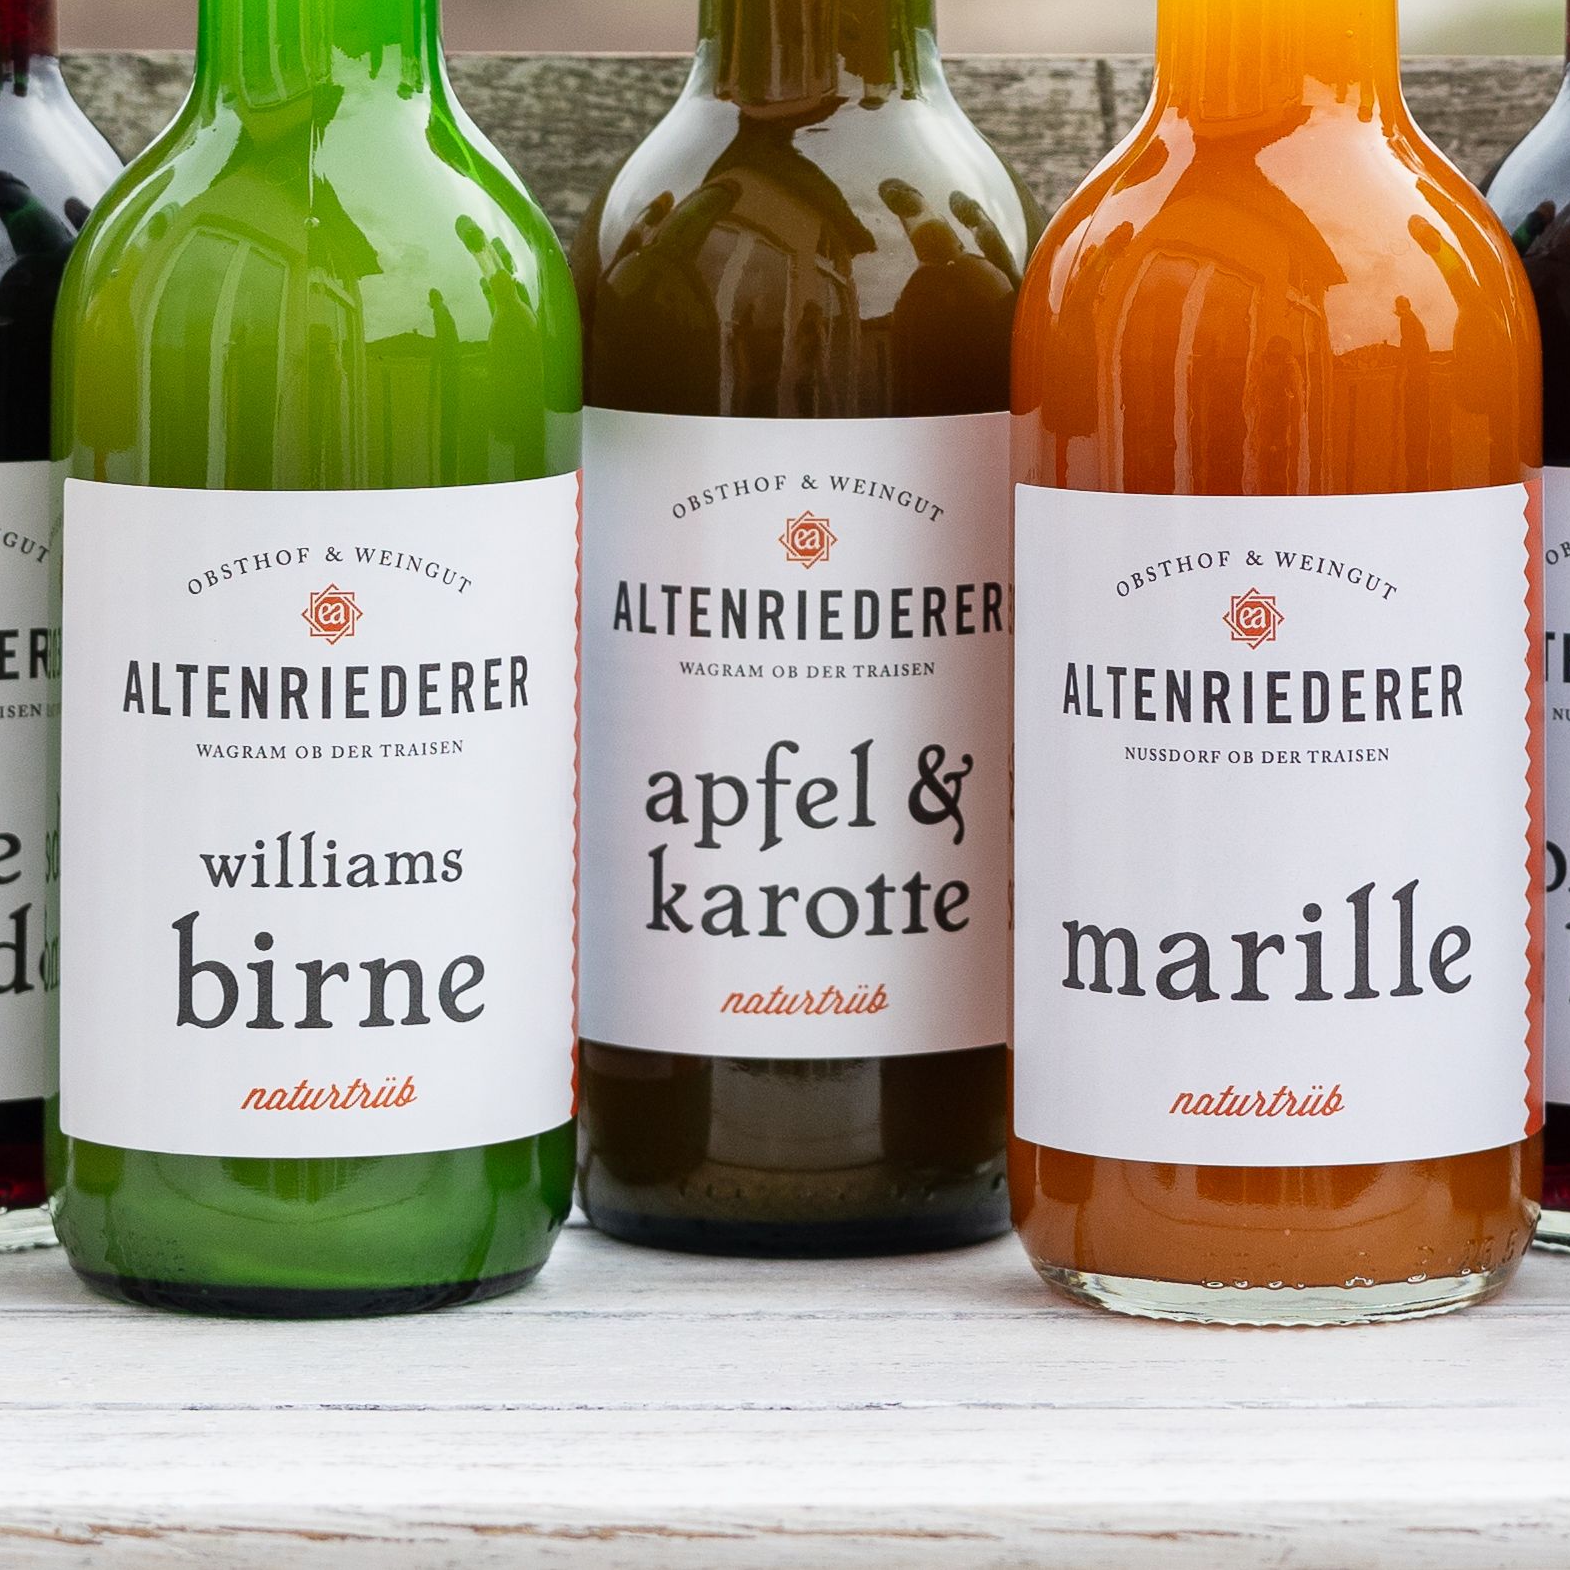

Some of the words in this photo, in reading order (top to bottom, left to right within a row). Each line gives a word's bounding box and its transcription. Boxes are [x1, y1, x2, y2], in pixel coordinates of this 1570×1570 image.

[673, 475, 789, 522] OBSTHOF
[801, 475, 817, 489] &
[827, 476, 943, 525] WEINGUT
[189, 548, 312, 598] OBSTHOF
[326, 547, 343, 562] &
[352, 547, 471, 597] WEINGUT
[1117, 551, 1234, 599] OBSTHOF
[1246, 550, 1263, 565] &
[1272, 551, 1397, 602] WEINGUT
[614, 581, 1002, 640] ALTENRIEDERER
[123, 656, 528, 719] ALTENRIEDERER
[680, 662, 763, 677] WAGRAM
[773, 666, 797, 678] OB
[807, 666, 846, 678] DER
[853, 662, 934, 677] TRAISEN
[1063, 662, 1463, 723] ALTENRIEDERER
[197, 744, 285, 758] WAGRAM
[296, 746, 322, 759] OB
[331, 745, 372, 758] DER
[380, 741, 462, 757] TRAISEN
[1125, 747, 1220, 763] NUSSDORF
[1228, 751, 1253, 763] OB
[1262, 751, 1301, 763] DER
[1307, 748, 1388, 763] TRAISEN
[646, 739, 876, 855] apfel
[908, 744, 973, 845] &
[199, 831, 462, 888] williams
[646, 842, 969, 939] karotte
[1062, 879, 1471, 1002] marille
[172, 911, 484, 1029] birne
[721, 984, 888, 1015] naturtrüb
[241, 1076, 417, 1110] naturtrüb
[1169, 1085, 1344, 1117] naturtrüb
